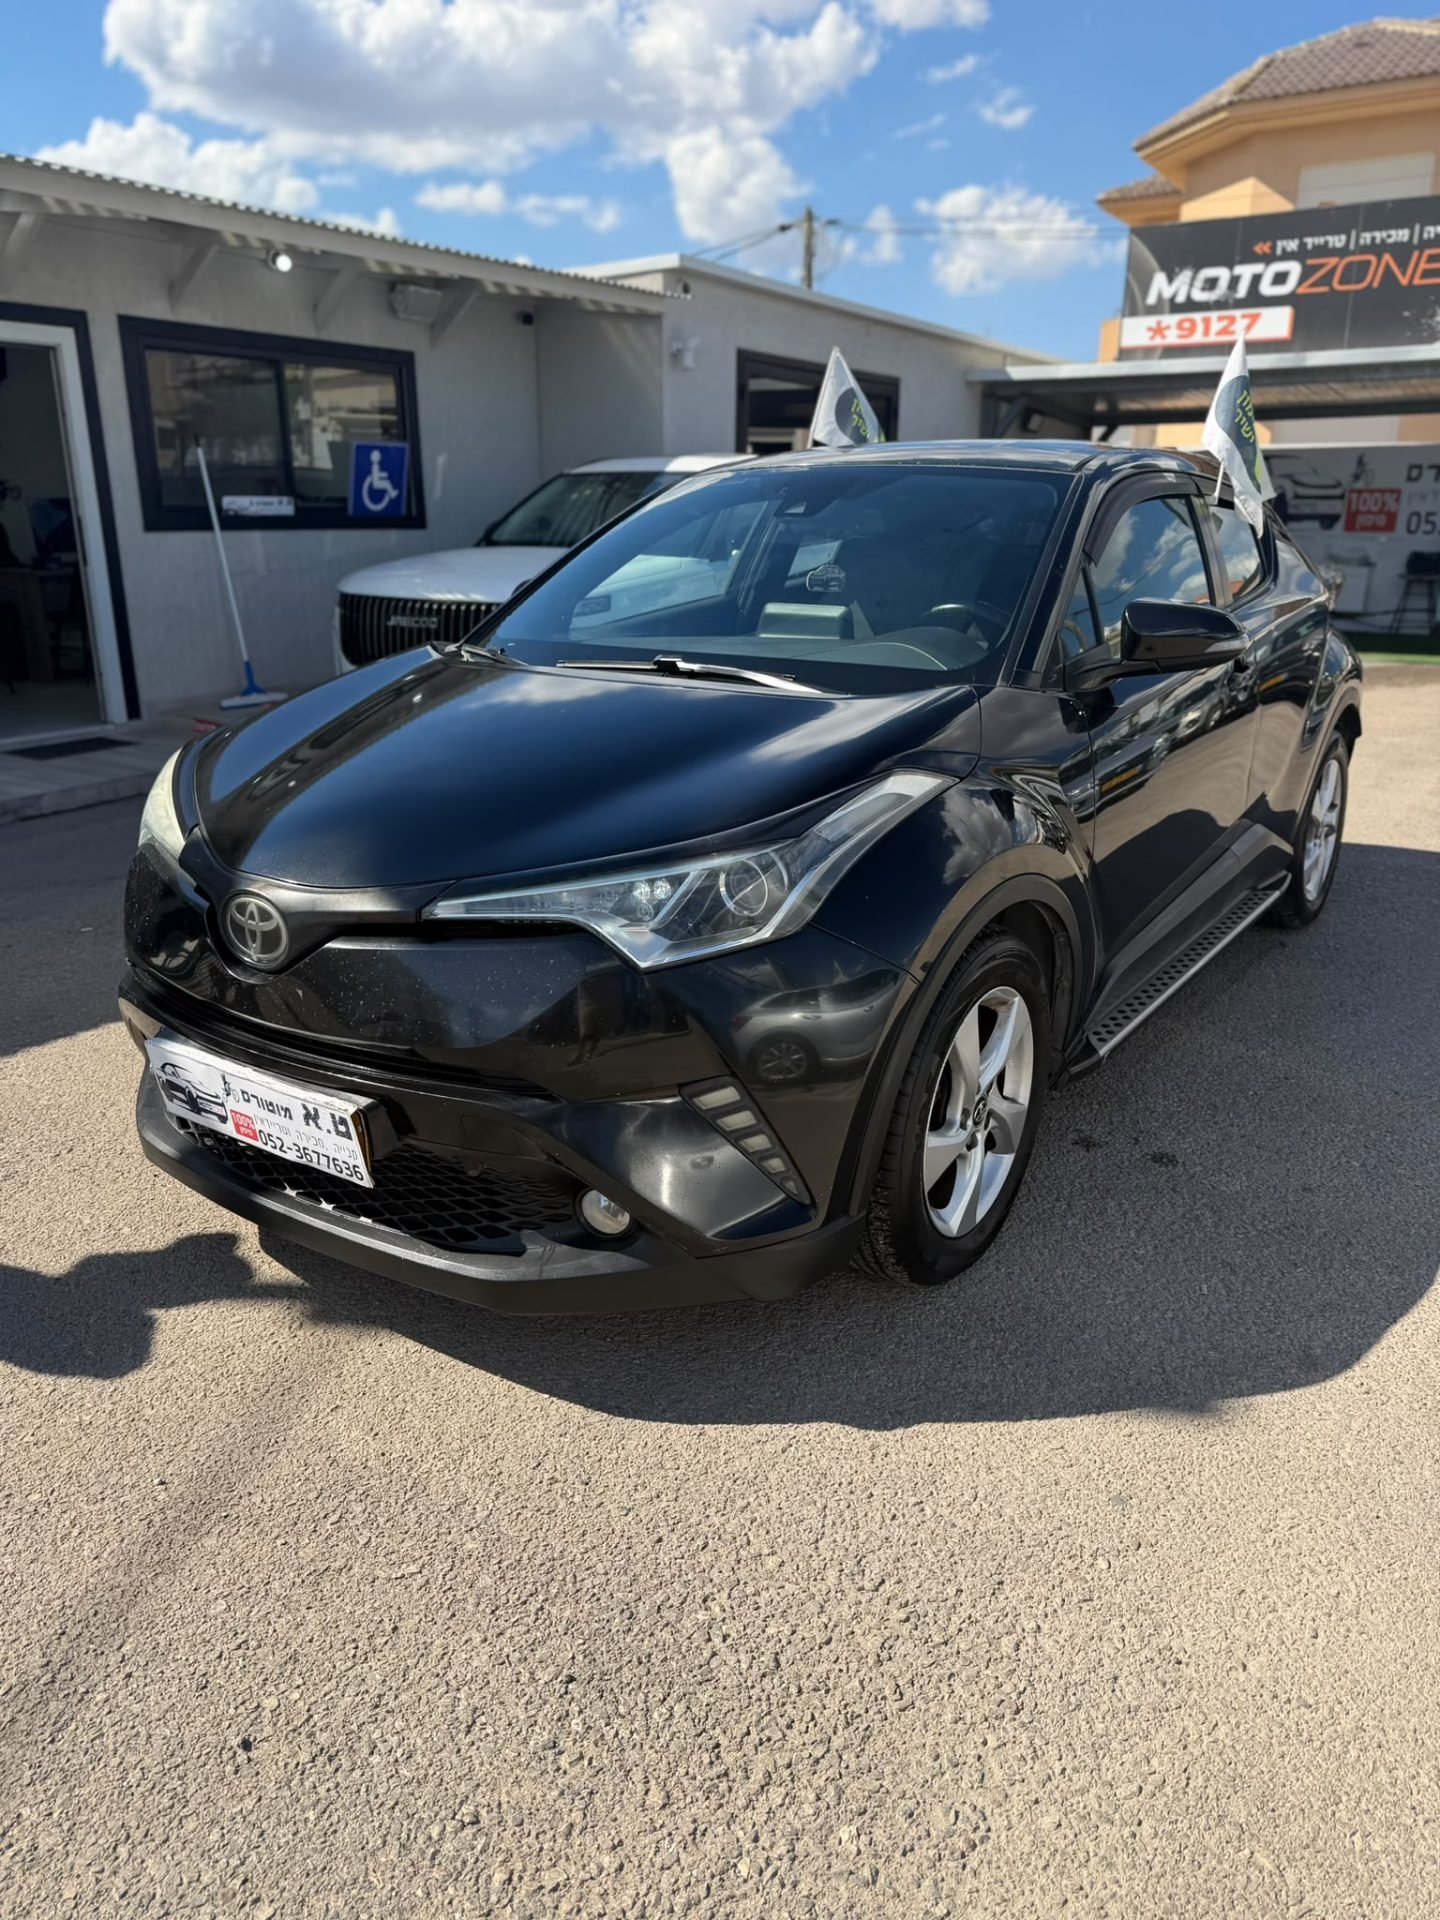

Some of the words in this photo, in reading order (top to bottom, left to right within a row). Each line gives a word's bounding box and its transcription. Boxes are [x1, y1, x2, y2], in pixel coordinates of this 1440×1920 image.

[1275, 237, 1300, 256] אין
[1303, 233, 1347, 250] טרייד
[1359, 228, 1410, 246] מכירה
[1350, 492, 1399, 512] 100%
[1405, 510, 1440, 535] 05
[231, 1111, 256, 1130] 100%
[258, 1128, 365, 1182] 052-3677636
